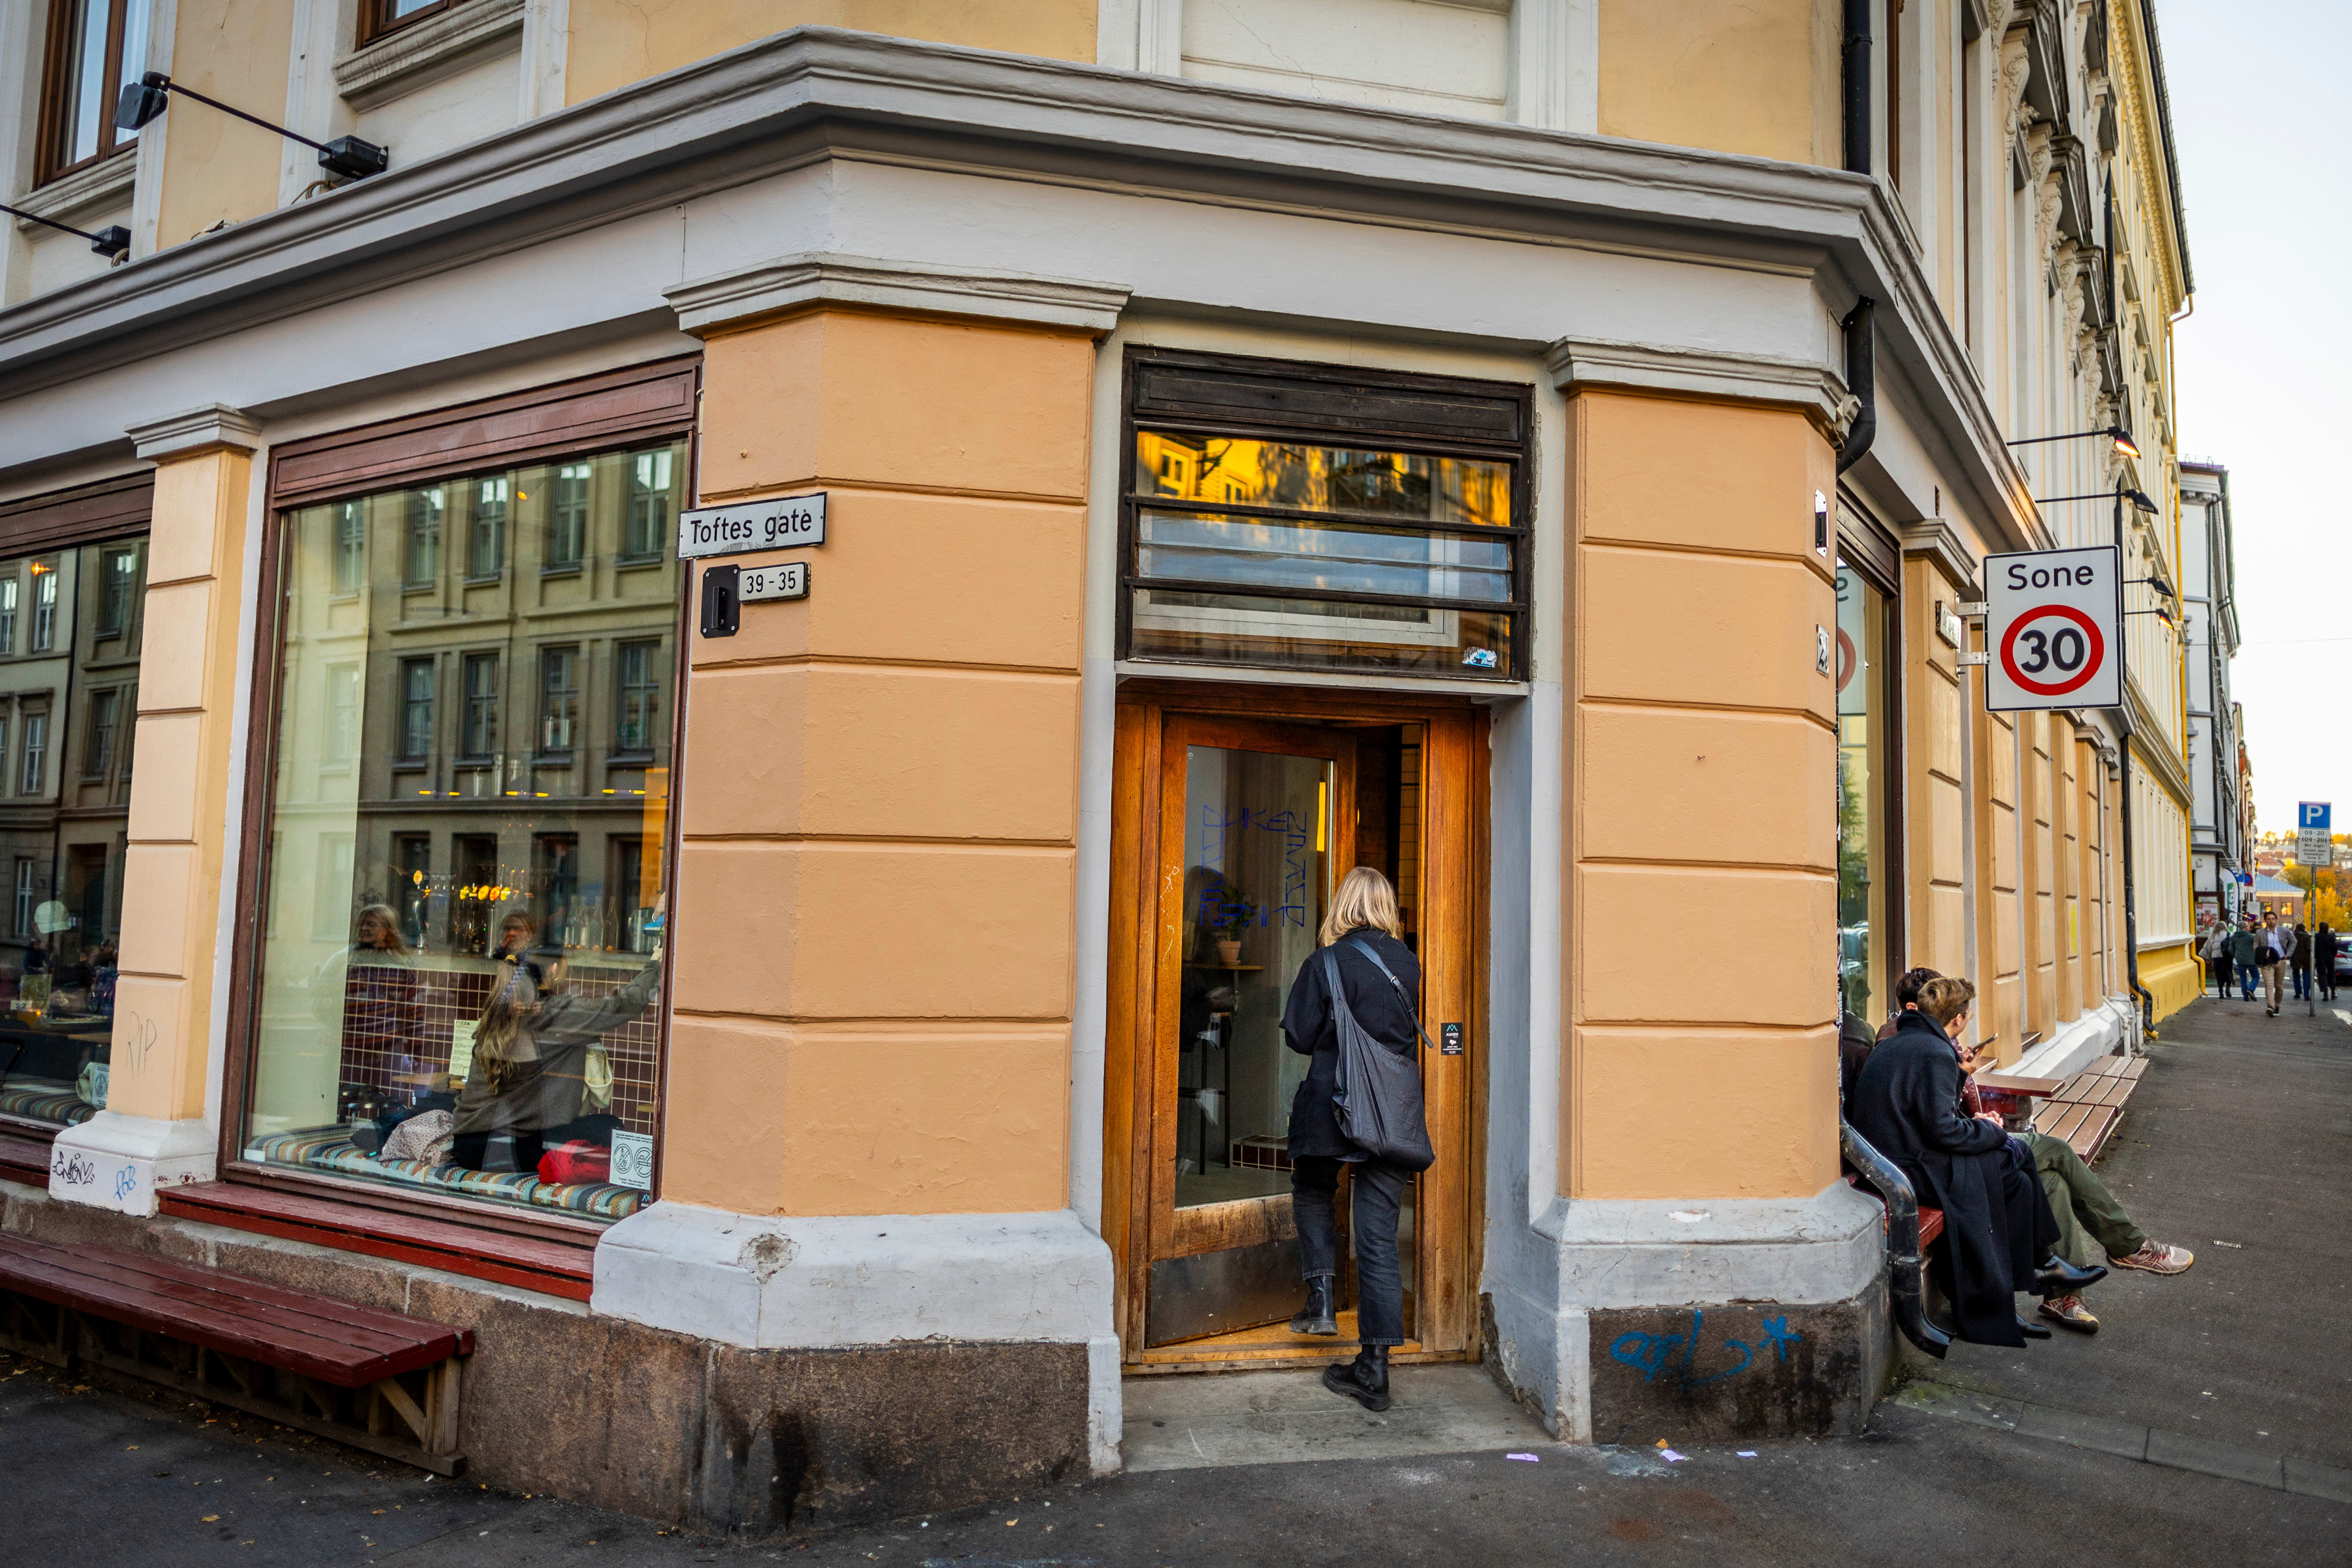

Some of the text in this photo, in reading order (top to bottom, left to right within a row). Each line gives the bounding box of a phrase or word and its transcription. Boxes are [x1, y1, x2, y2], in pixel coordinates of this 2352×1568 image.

[690, 508, 812, 544] Toftes gate
[2007, 563, 2094, 590] Sone
[2020, 628, 2085, 673] 30
[2306, 804, 2323, 825] P
